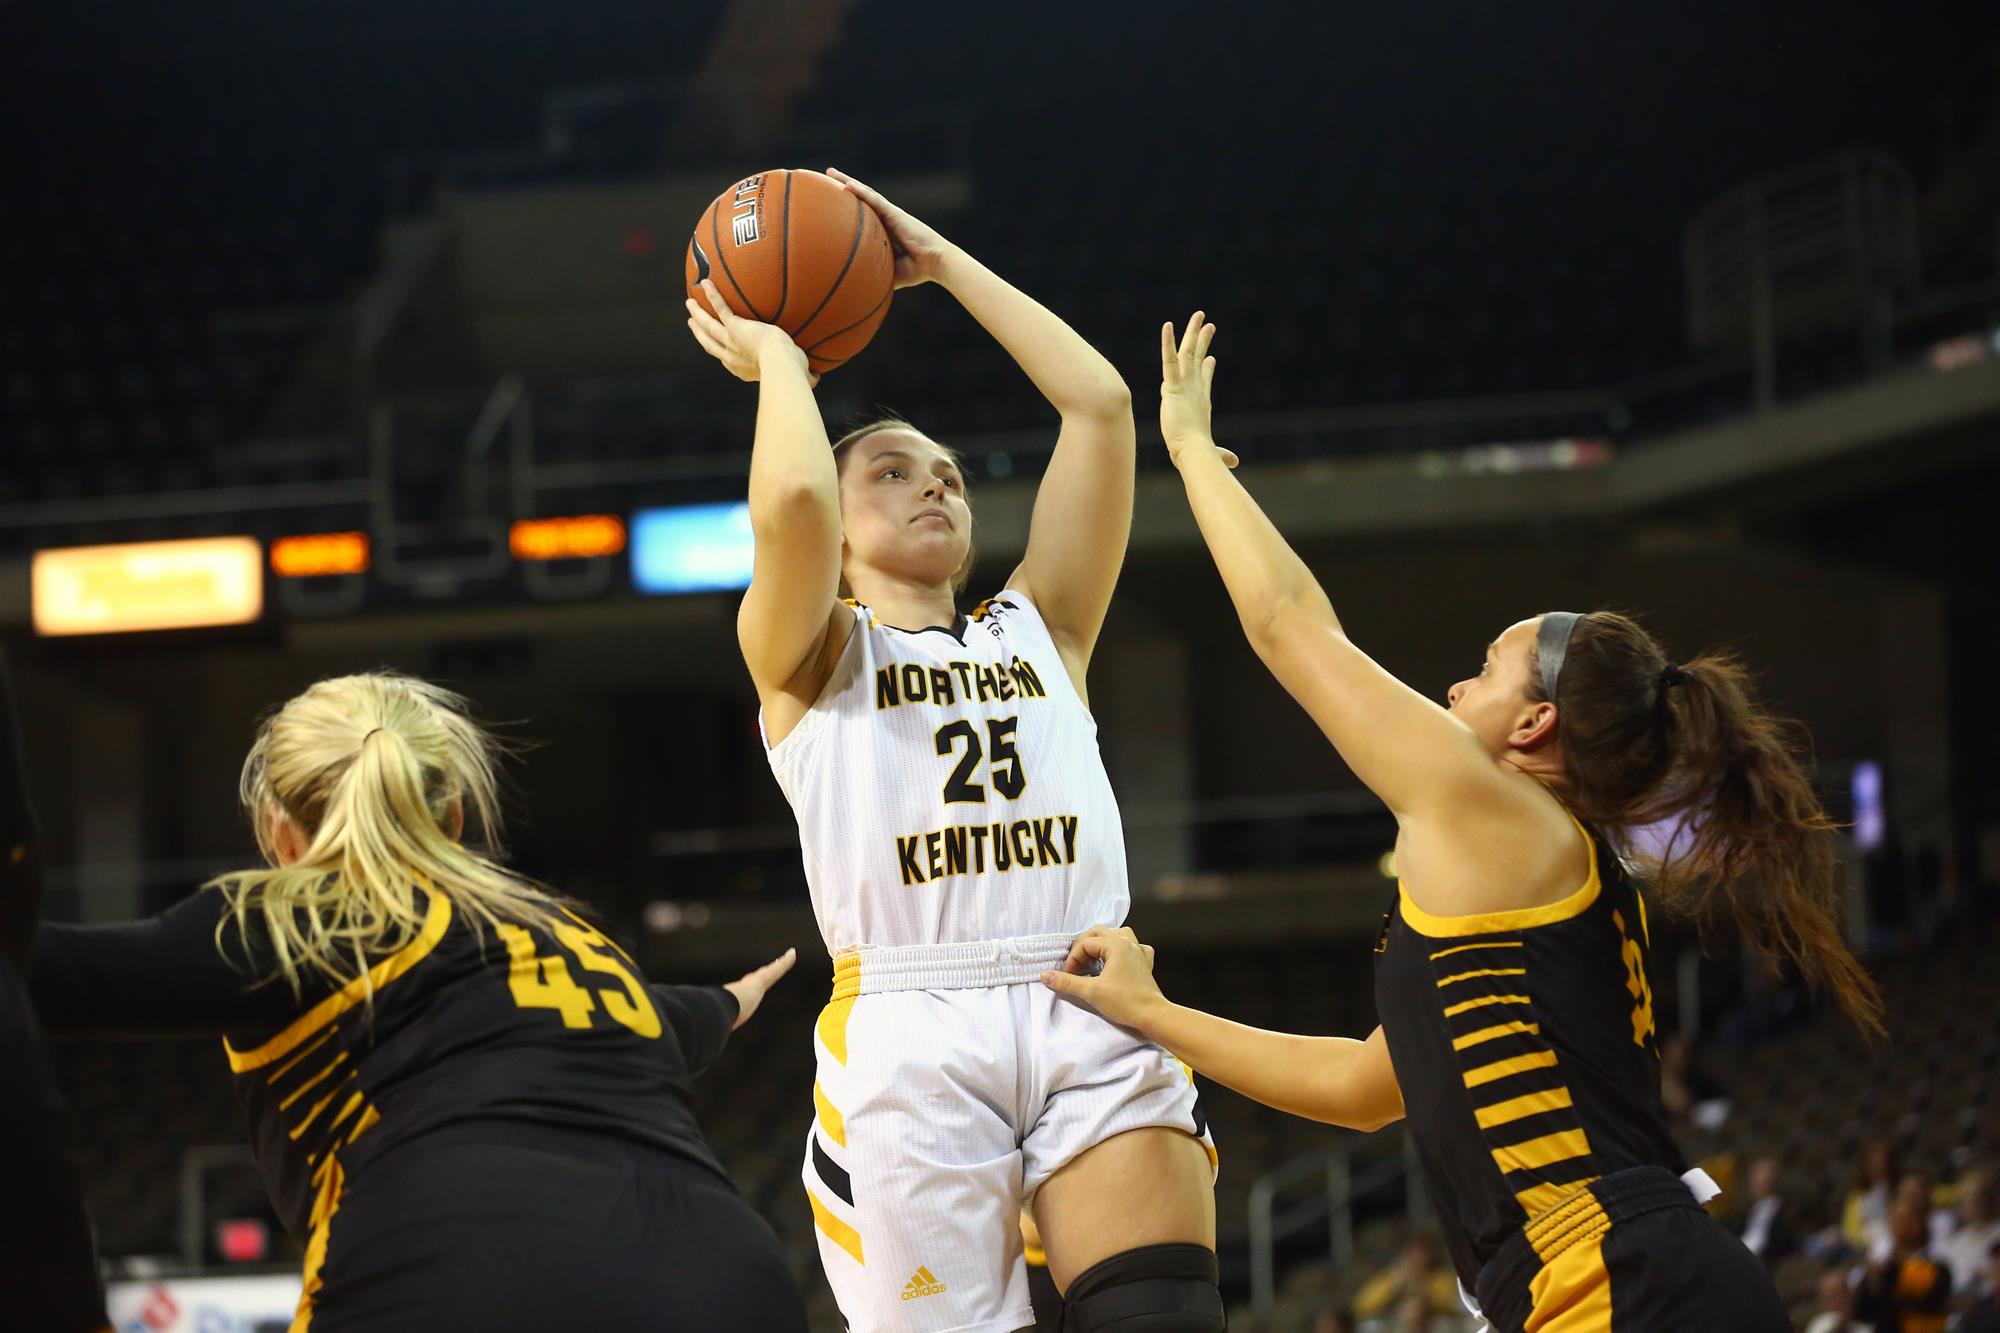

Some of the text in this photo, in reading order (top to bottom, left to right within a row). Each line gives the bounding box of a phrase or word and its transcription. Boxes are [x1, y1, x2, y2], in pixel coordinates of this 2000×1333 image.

[935, 716, 1026, 804] 25
[896, 815, 1078, 886] KENTUCKY
[496, 916, 662, 1039] 45
[901, 1283, 948, 1301] adidas
